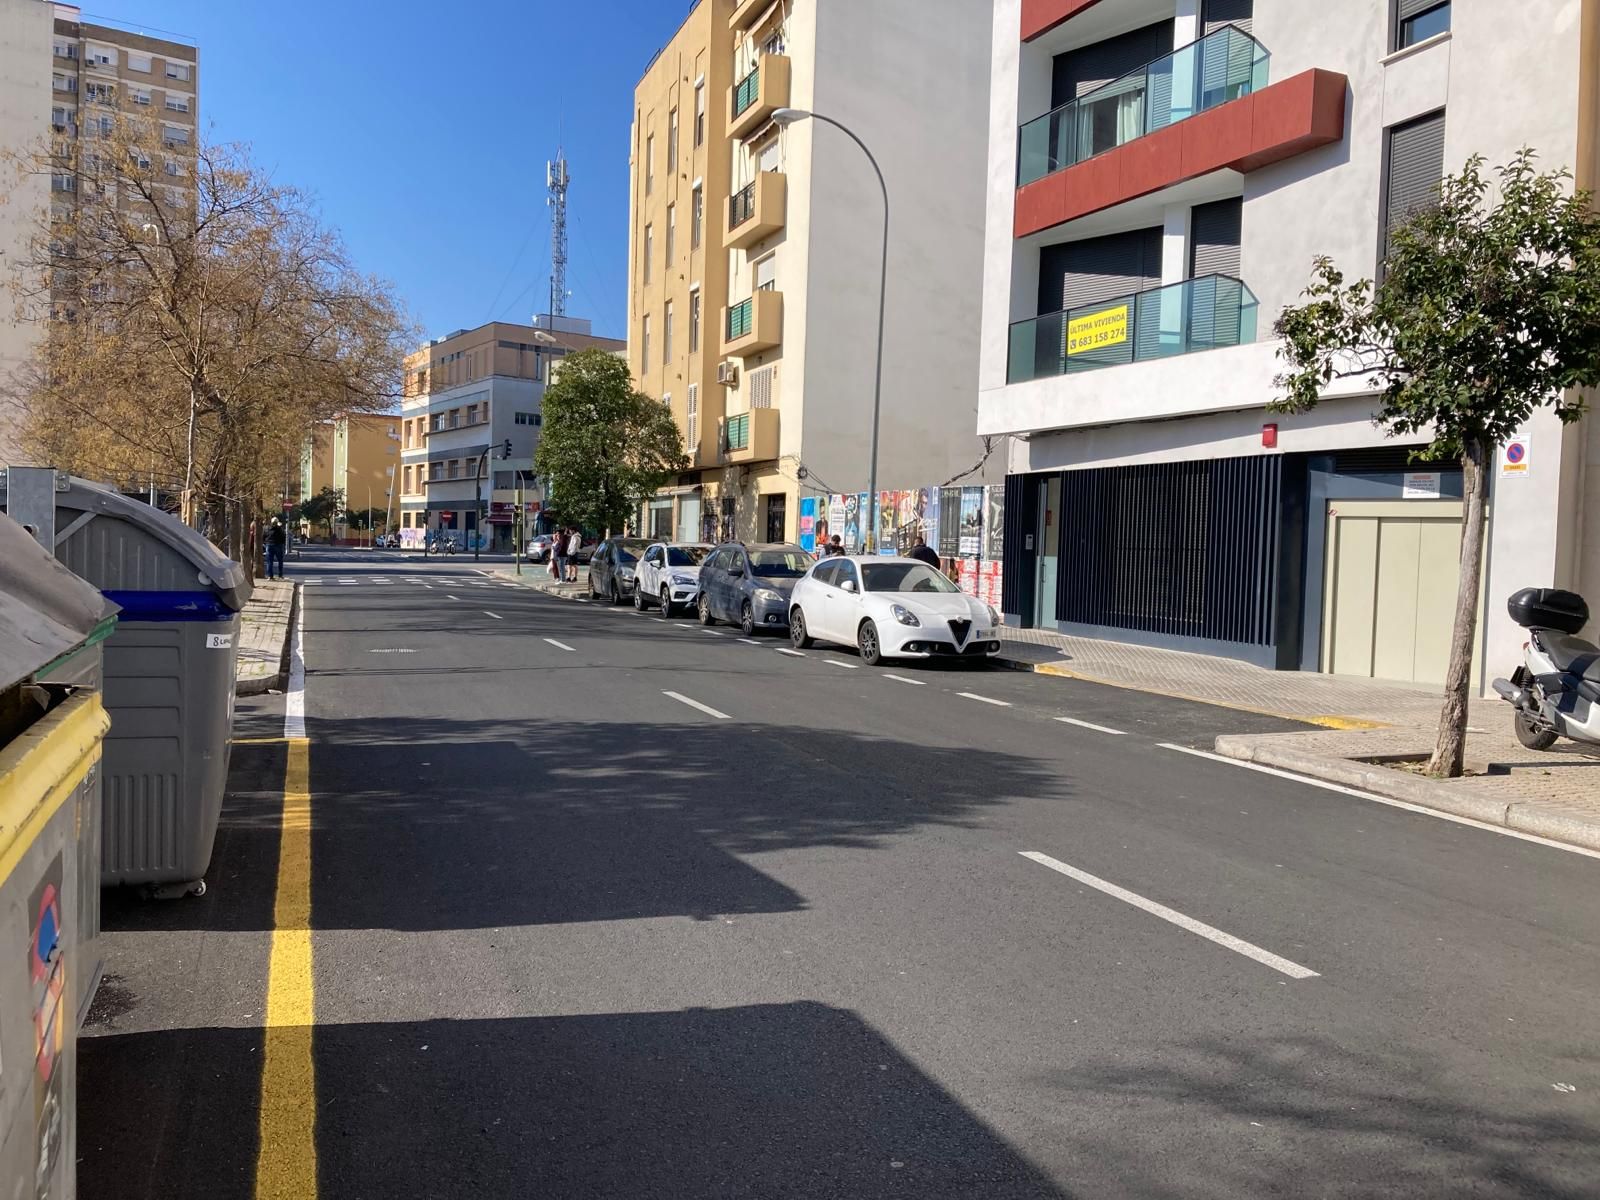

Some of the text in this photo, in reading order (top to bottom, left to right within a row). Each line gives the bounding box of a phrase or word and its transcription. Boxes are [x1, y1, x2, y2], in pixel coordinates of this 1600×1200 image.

[1070, 313, 1126, 335] ÚLTIMA VIVIENDA
[1078, 327, 1126, 348] 683 158 274
